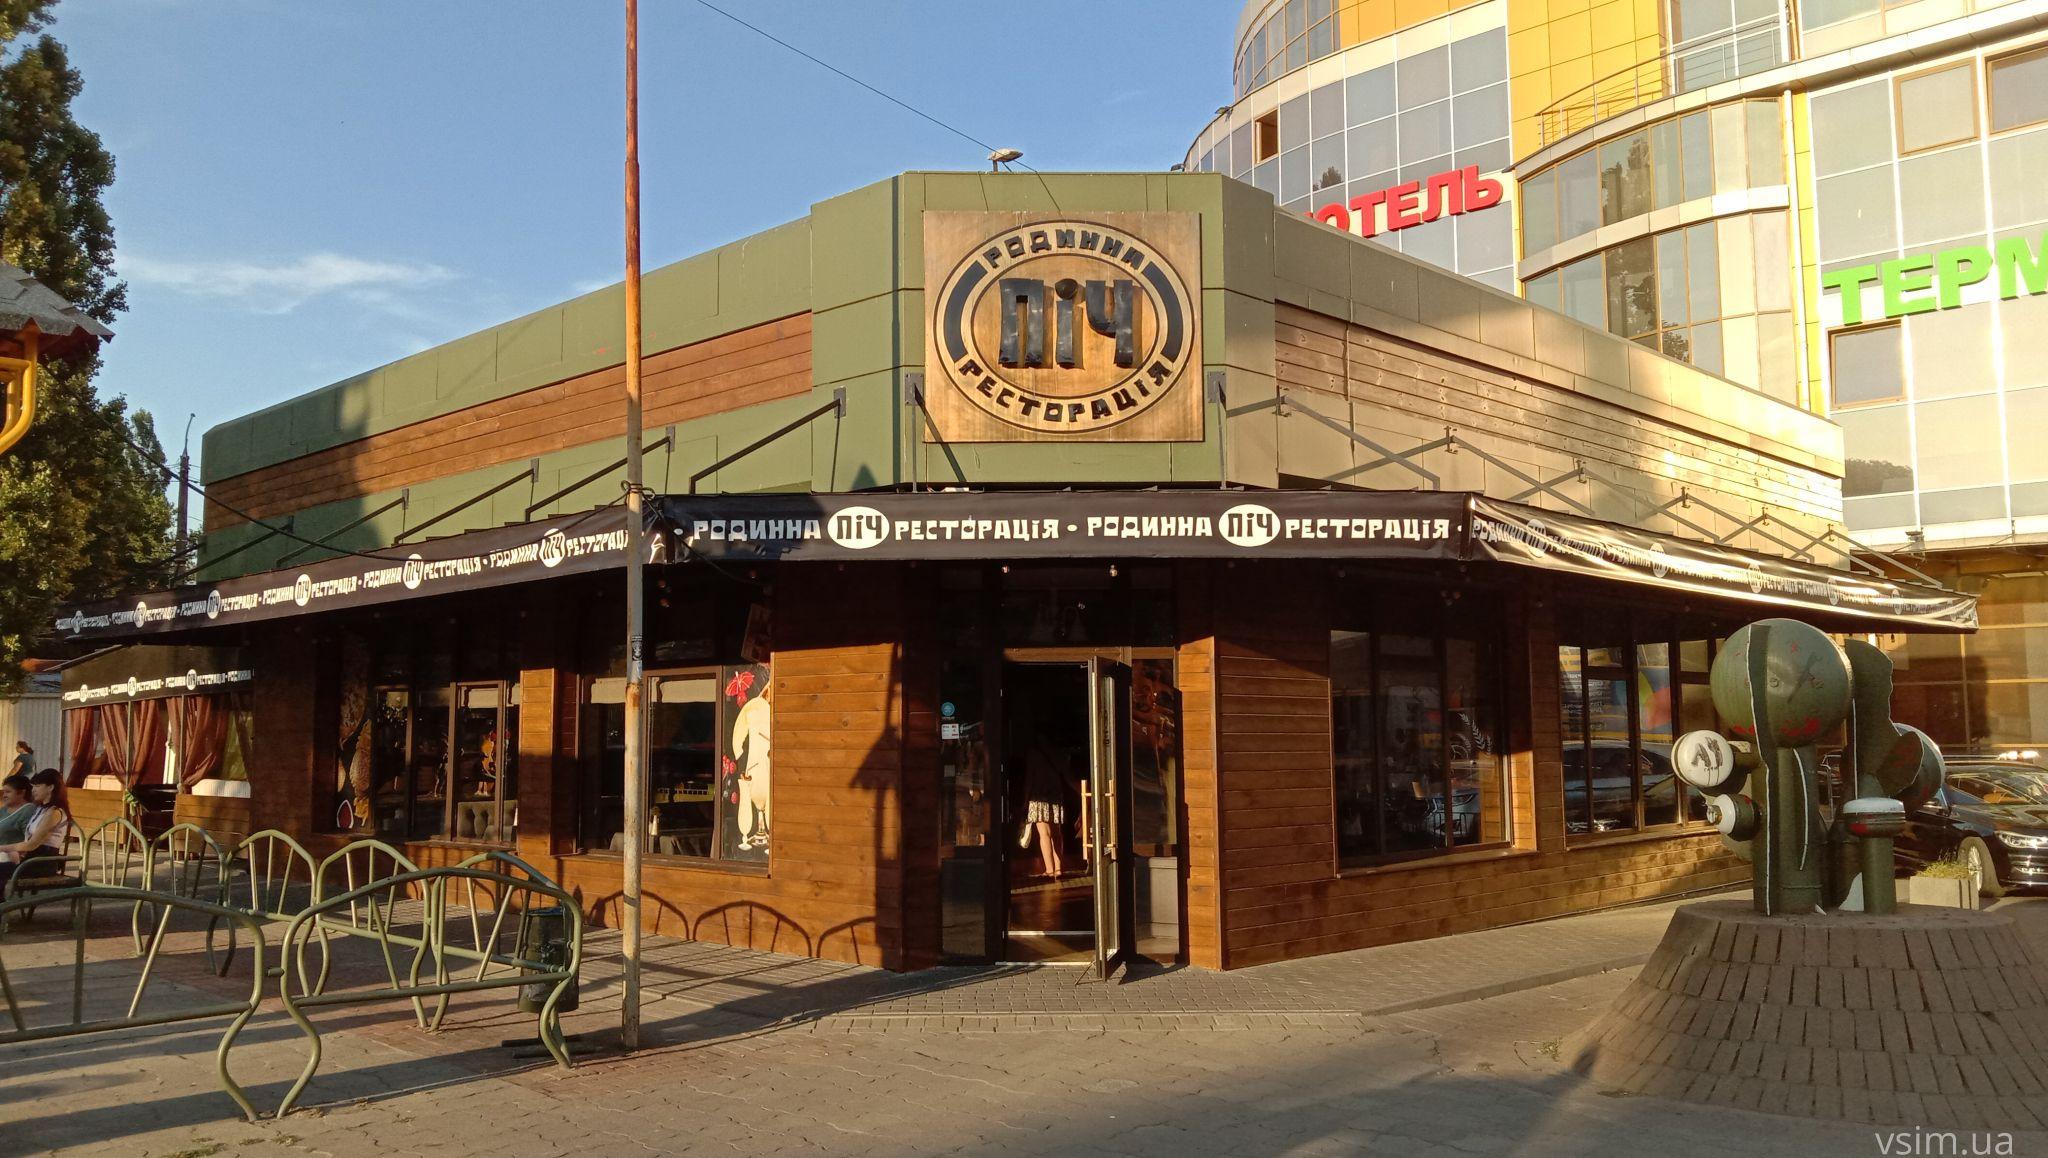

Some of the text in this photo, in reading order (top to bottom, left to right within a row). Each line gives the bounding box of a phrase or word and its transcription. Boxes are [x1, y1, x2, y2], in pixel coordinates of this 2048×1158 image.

[1304, 165, 1503, 238] ОТЕЛЬ
[983, 228, 1145, 270] РОДИННА
[959, 358, 1174, 423] РЕСТОРАЦІЯ
[693, 519, 822, 543] РОДИННА
[1086, 515, 1213, 539] РОДИННА
[363, 566, 402, 588] РОДИННА
[489, 542, 539, 569] РОДИННА
